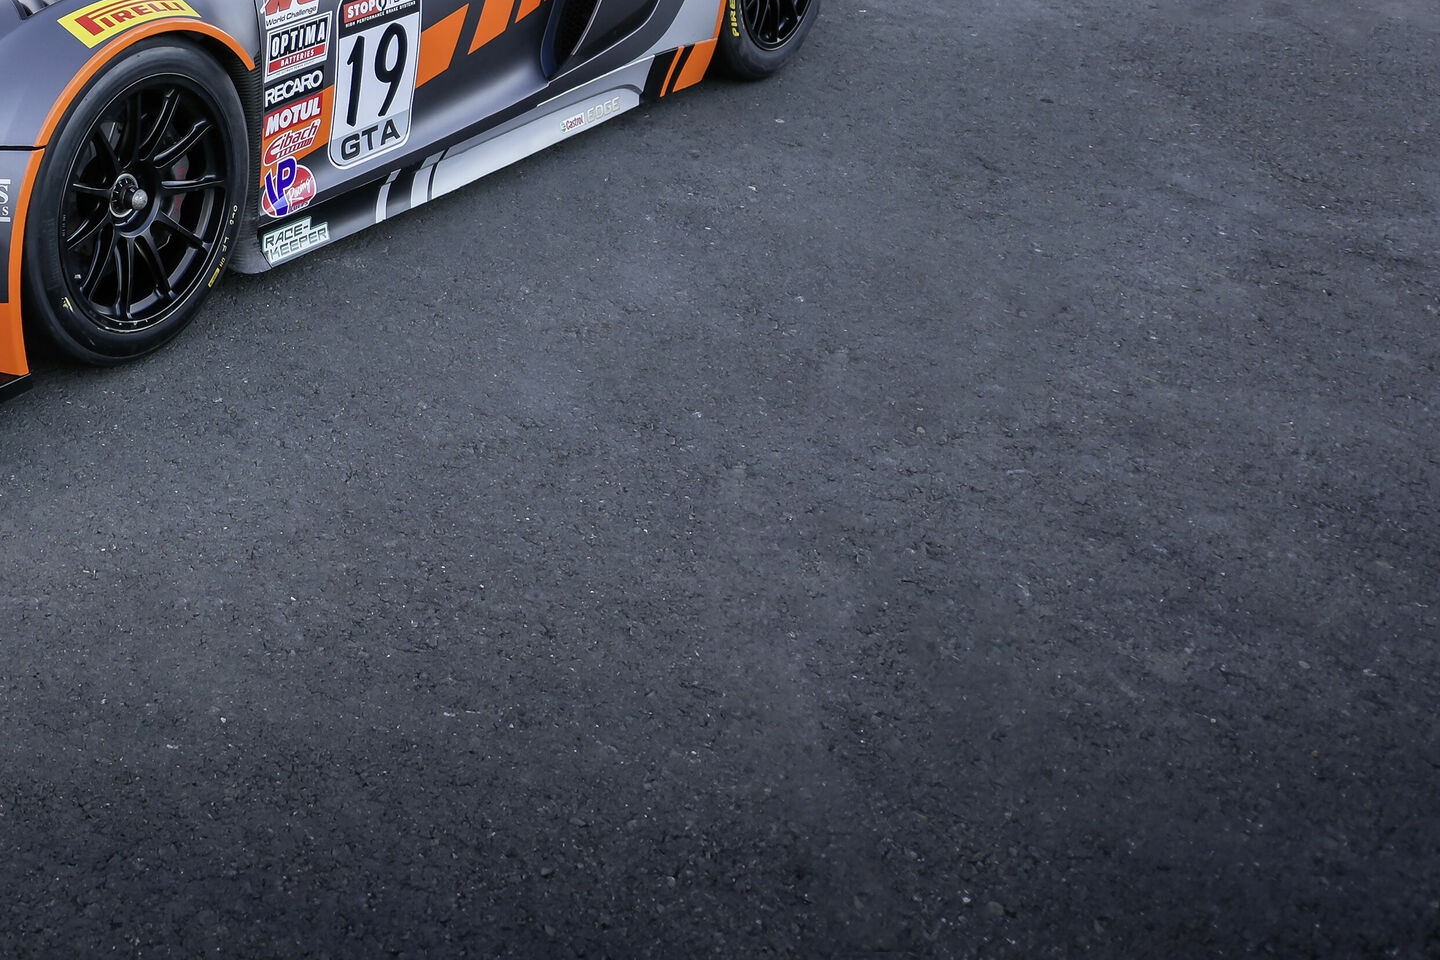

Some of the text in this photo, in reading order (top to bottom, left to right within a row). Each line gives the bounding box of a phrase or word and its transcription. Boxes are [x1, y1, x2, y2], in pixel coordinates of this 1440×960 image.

[266, 5, 317, 27] World Challenge
[271, 21, 326, 57] OPTIMA
[280, 48, 315, 67] BATTERIES
[265, 70, 323, 108] RECARO
[346, 22, 408, 127] 19
[265, 97, 321, 137] MOTUL
[341, 119, 401, 161] GTA
[265, 158, 296, 216] VP
[265, 223, 309, 249] RACE-
[269, 227, 327, 260] KEEPER
